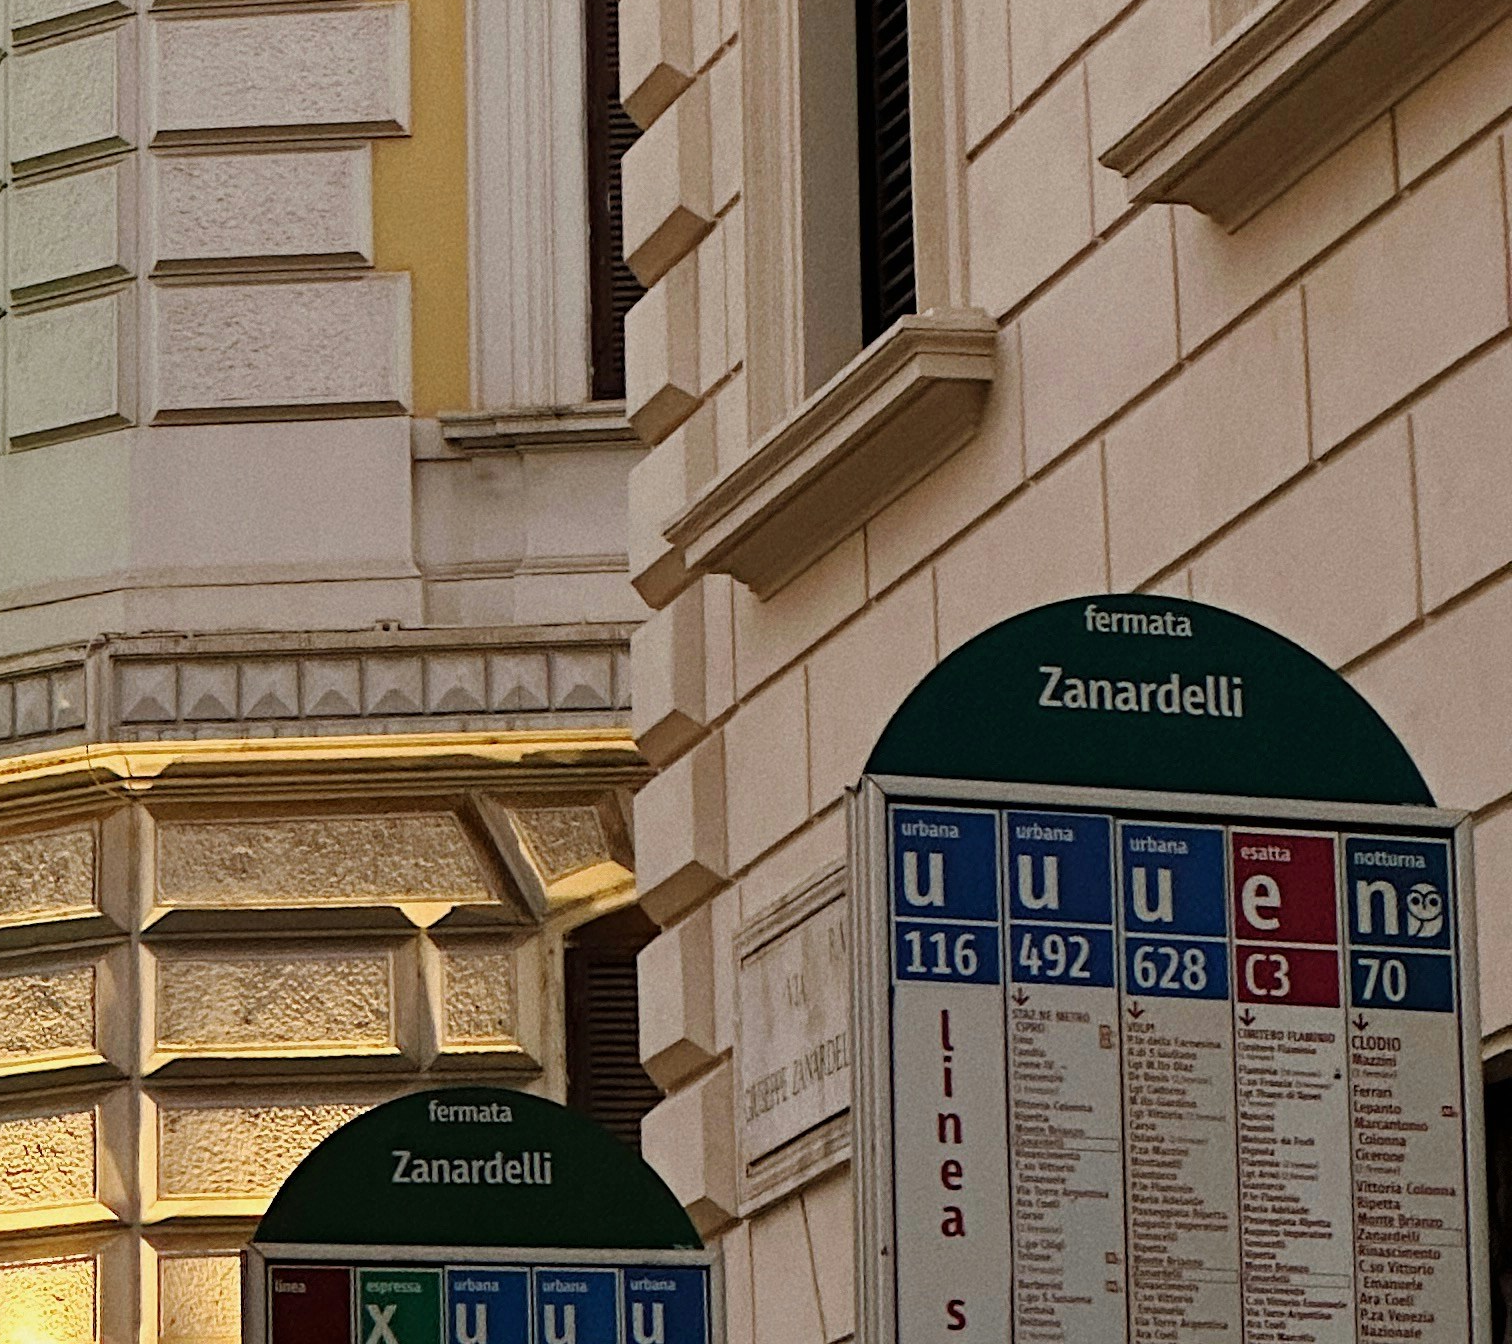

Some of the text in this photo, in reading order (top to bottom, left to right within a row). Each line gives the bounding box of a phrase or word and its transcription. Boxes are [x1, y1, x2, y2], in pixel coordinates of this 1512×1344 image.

[1084, 604, 1193, 637] fermata
[1038, 666, 1243, 718] Zanardelli
[901, 820, 960, 839] urbana
[1015, 823, 1074, 843] urbana
[1129, 836, 1189, 855] urbana
[1240, 844, 1291, 863] esatta
[1353, 849, 1427, 869] notturna
[903, 851, 945, 907] u
[1017, 854, 1059, 910] u
[1131, 867, 1174, 923] u
[1241, 875, 1282, 931] e
[1355, 879, 1400, 936] n
[904, 930, 978, 976] 116
[1019, 933, 1091, 979] 492
[1133, 945, 1208, 991] 628
[1245, 953, 1291, 997] C3
[1357, 957, 1407, 1003] 70
[1352, 1035, 1401, 1052] CLODIO
[792, 1032, 851, 1096] ZANARDEL
[429, 1100, 513, 1122] fermata
[1354, 1101, 1402, 1115] Lepanto
[1359, 1133, 1406, 1146] Colonna
[392, 1150, 552, 1185] Zanardelli
[1355, 1180, 1456, 1196] Vittoria Colonna
[1356, 1197, 1401, 1210] Ripetta
[1357, 1213, 1394, 1226] Monte
[1357, 1228, 1420, 1242] Zanardelli
[1388, 1262, 1434, 1275] Vittorio
[275, 1280, 306, 1293] linea
[365, 1280, 423, 1294] espressa
[454, 1279, 499, 1293] urbana
[543, 1279, 588, 1294] urbana
[630, 1278, 677, 1292] urbana
[1364, 1277, 1423, 1290] Emanuele
[1360, 1293, 1414, 1307] Ara Coeli
[364, 1304, 398, 1344] x
[455, 1303, 487, 1344] u
[543, 1304, 576, 1344] u
[632, 1302, 665, 1344] u
[1388, 1311, 1435, 1323] Venezia
[1361, 1324, 1422, 1338] Nazionale
